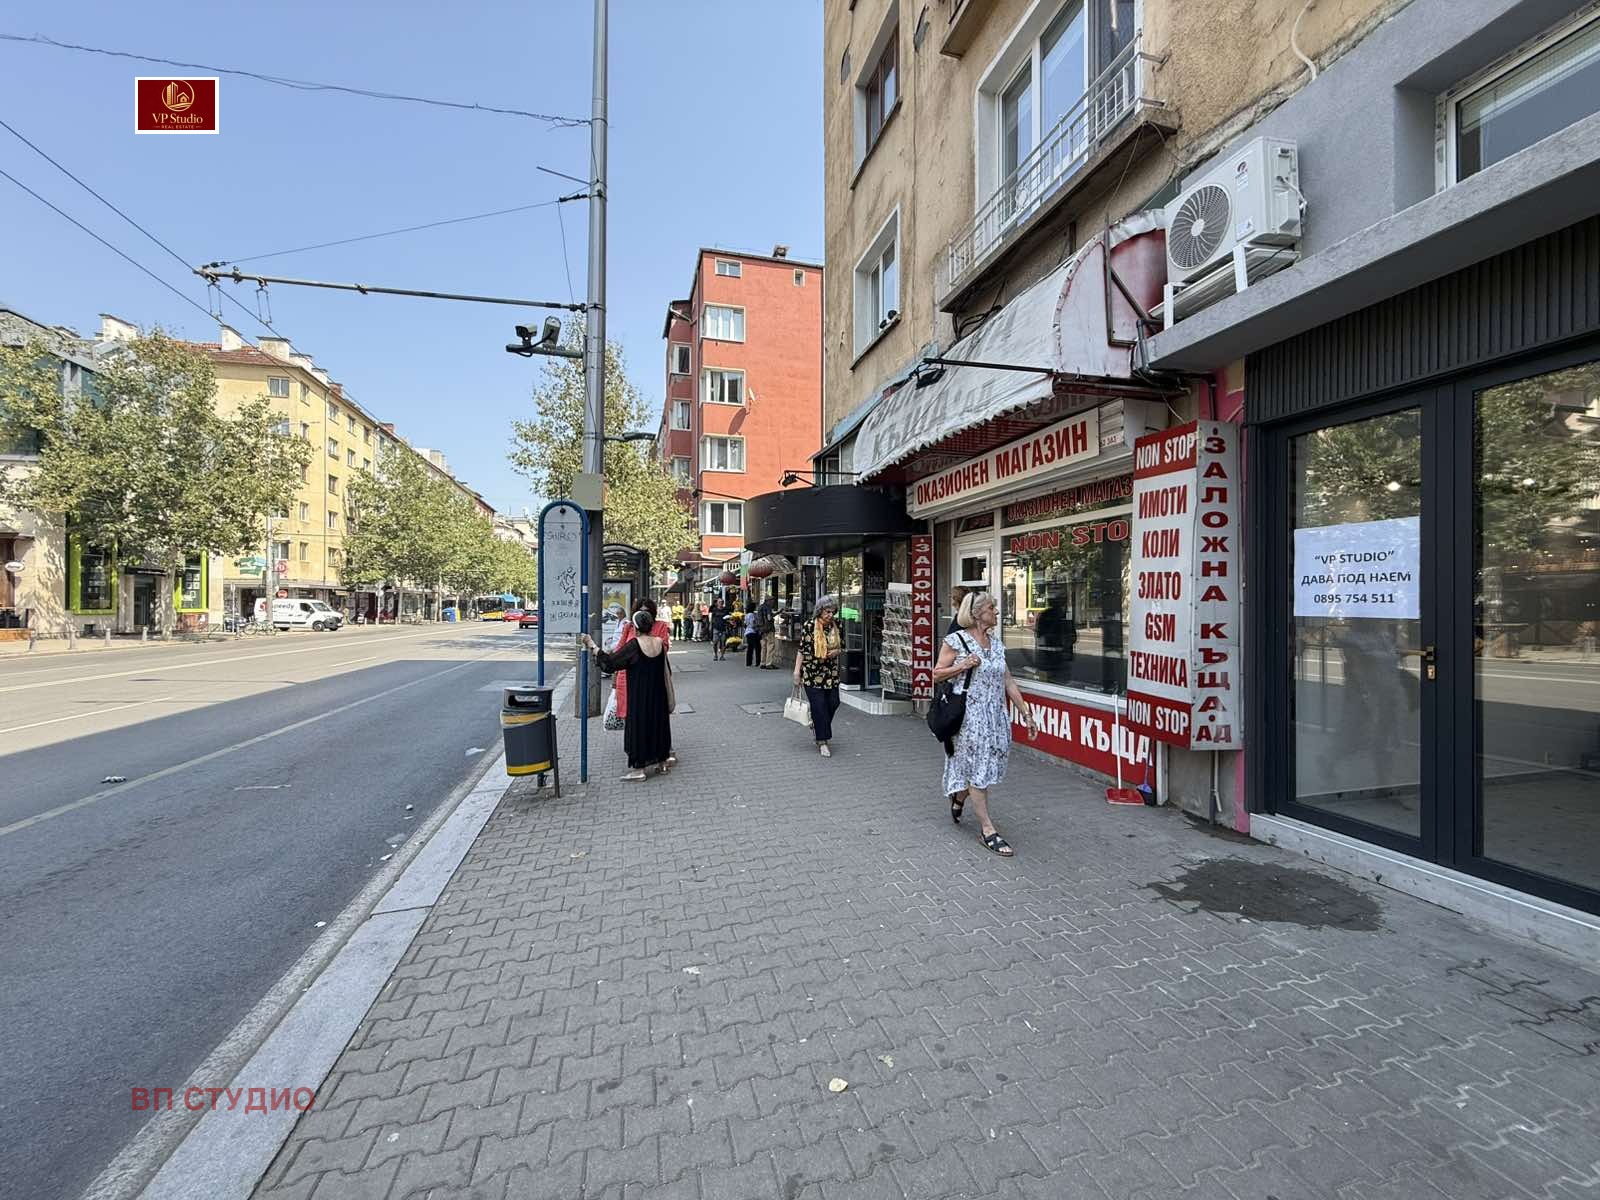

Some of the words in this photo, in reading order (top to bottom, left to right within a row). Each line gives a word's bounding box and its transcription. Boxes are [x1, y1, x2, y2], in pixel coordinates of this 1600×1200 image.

[917, 460, 989, 505] ОКАЗИОНЕН
[995, 421, 1088, 481] МАГАЗИН
[1136, 442, 1160, 470] NON
[1164, 432, 1196, 464] STOP
[1007, 487, 1077, 521] ОКАЗИОНЕН
[1139, 485, 1187, 519] ИМОТИ
[1201, 437, 1229, 602] ЗАЛОЖНА
[1011, 530, 1060, 555] NON
[1142, 528, 1180, 558] КОЛИ
[914, 544, 931, 626] ЗАЛОЖНА
[1138, 571, 1181, 600] ЗЛАТО
[1301, 575, 1334, 586] ДАВА
[1337, 573, 1366, 585] ПОД
[1369, 571, 1411, 582] НАЕМ
[1313, 594, 1341, 604] 0895
[1345, 594, 1368, 604] 754
[1371, 593, 1395, 603] 511
[1145, 612, 1176, 643] GSM
[913, 636, 932, 682] КЪЩА
[1130, 650, 1188, 688] ТЕХНИКА
[1197, 622, 1230, 713] КЪЩА
[1128, 699, 1151, 726] NON
[1156, 706, 1189, 736] STOP
[1080, 715, 1153, 767] КЪЩА
